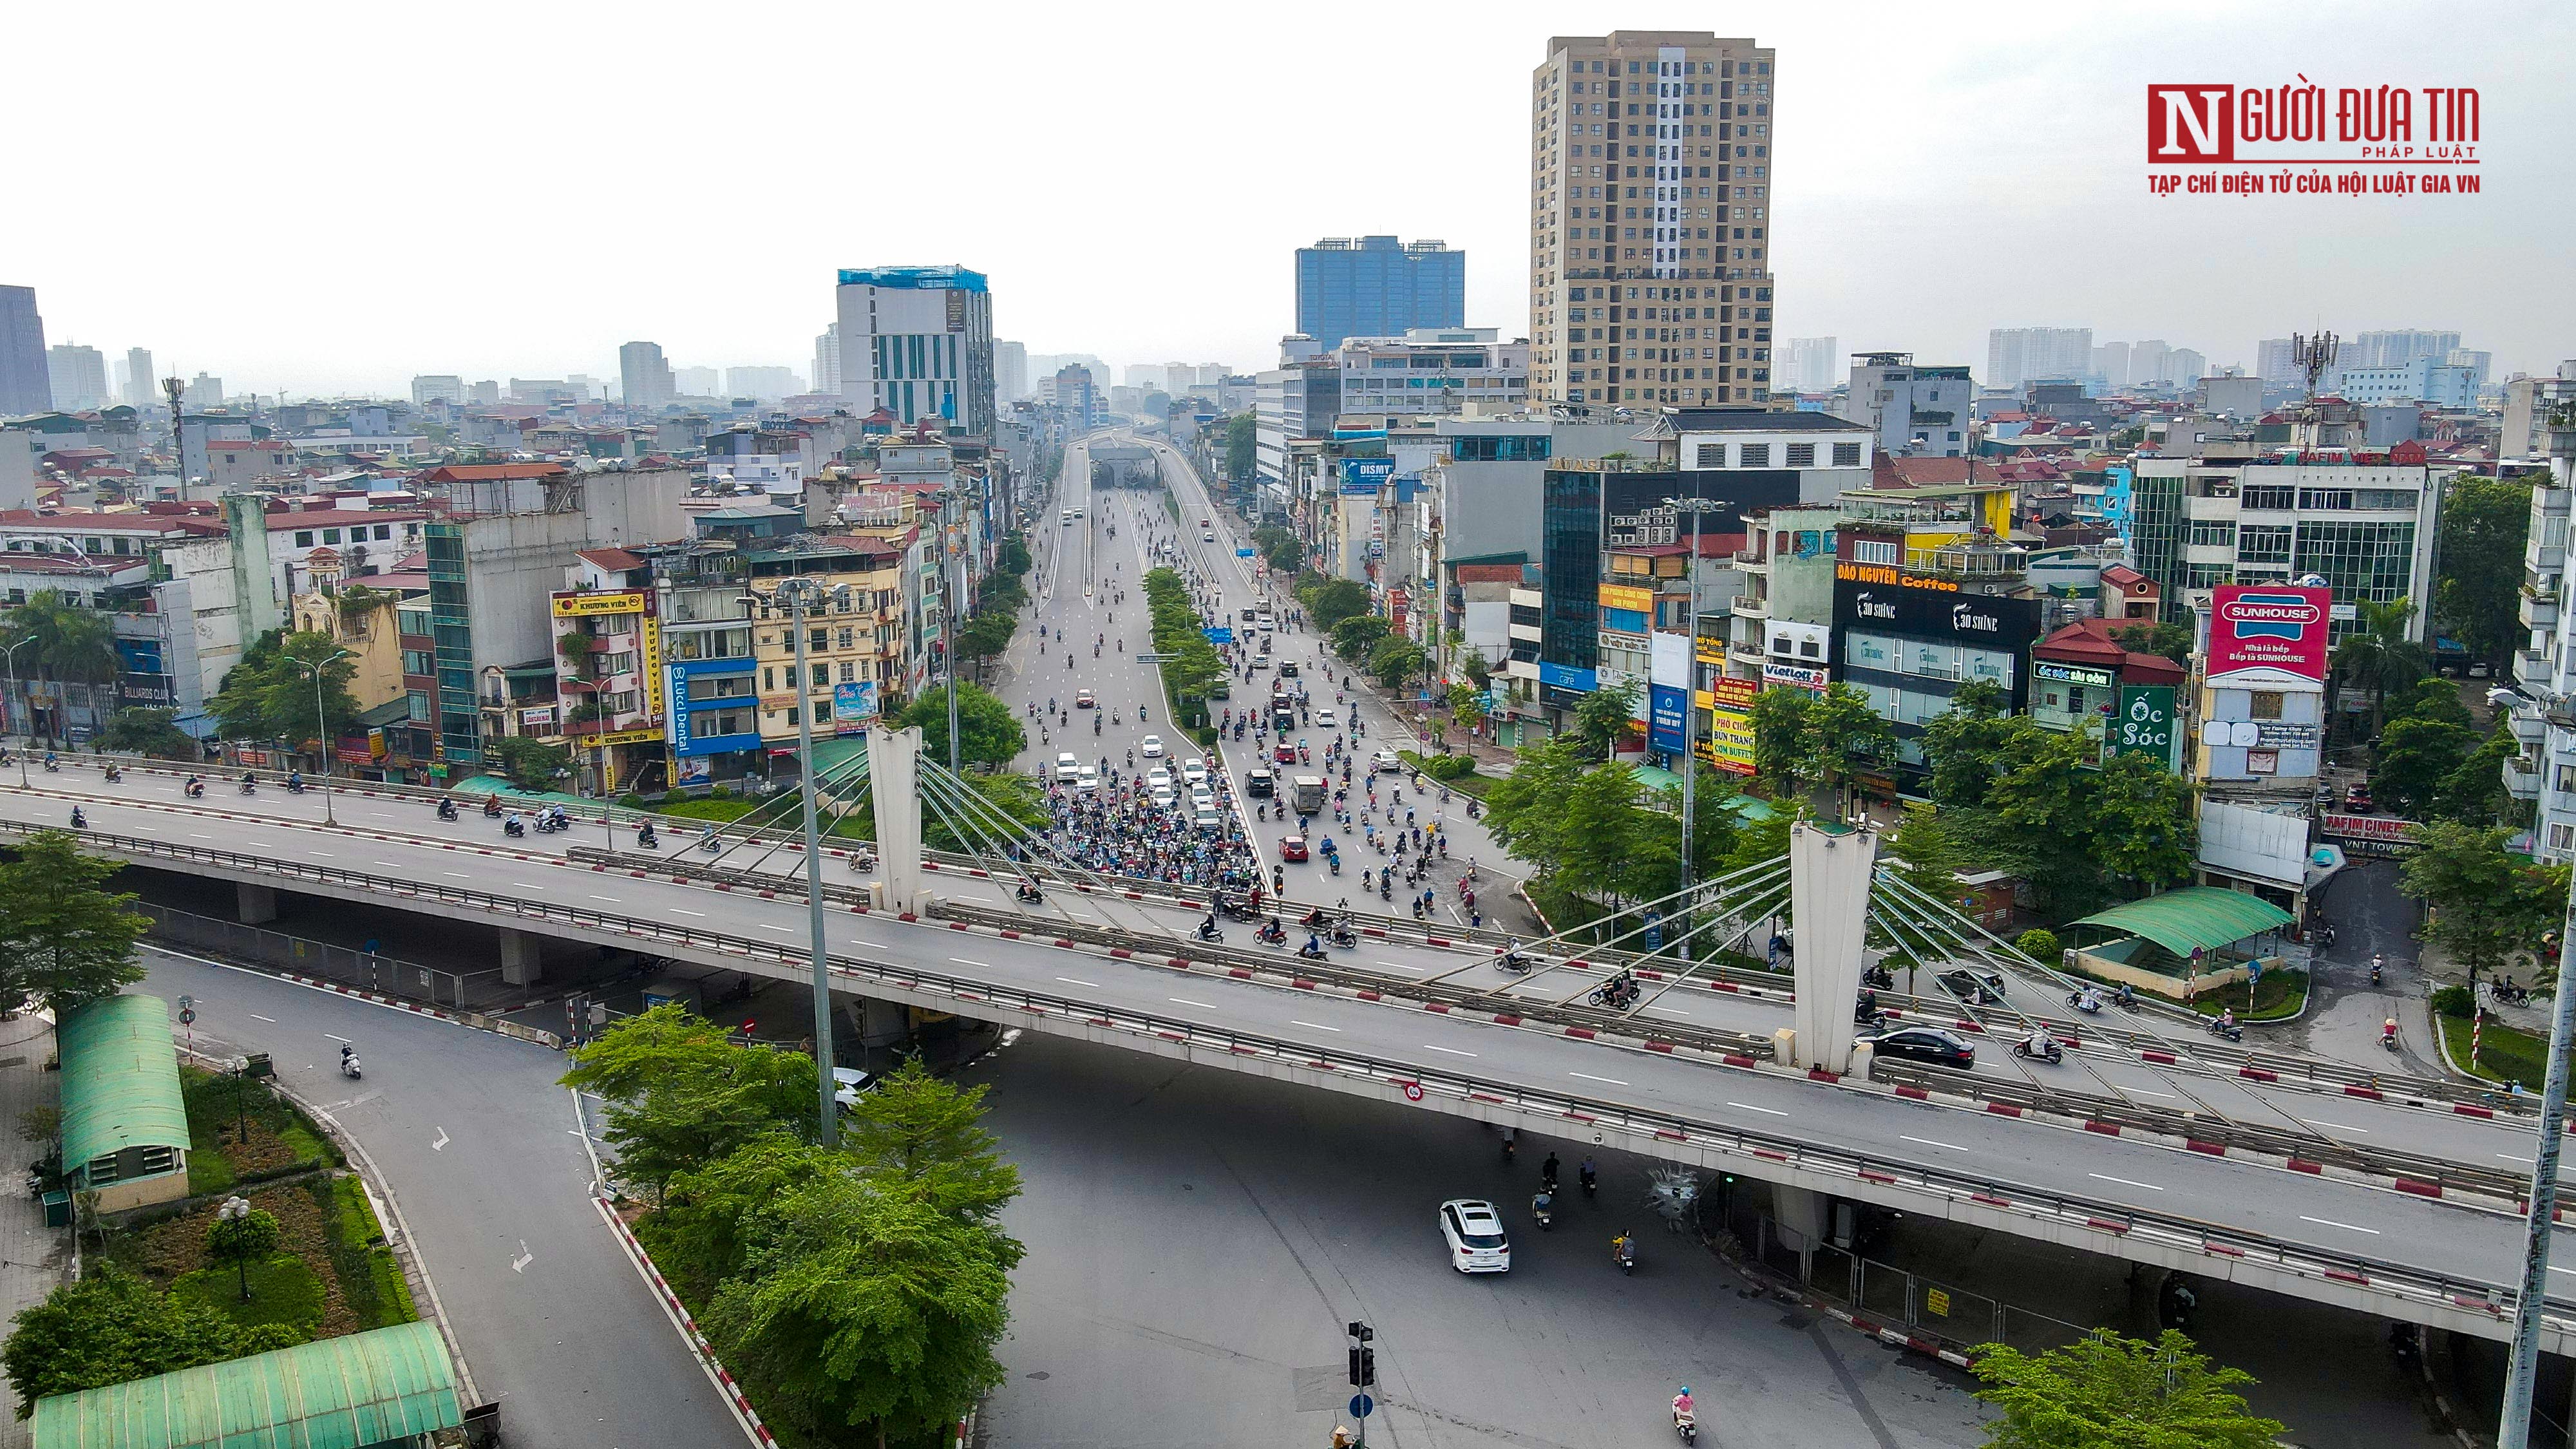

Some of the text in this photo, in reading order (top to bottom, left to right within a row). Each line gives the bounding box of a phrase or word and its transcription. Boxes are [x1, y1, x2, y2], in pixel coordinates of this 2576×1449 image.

[1360, 464, 1390, 475] DISMY
[1838, 562, 1958, 592] ĐÀO NGUYÊN Coffee
[2231, 606, 2309, 620] SUNHOUSE
[2273, 643, 2289, 654] bếp
[2229, 651, 2246, 661] Bếp
[2257, 654, 2306, 663] SUNHOUSE
[125, 687, 153, 699] BILLIARDS
[2131, 692, 2163, 723] Ốc
[1716, 716, 1730, 728] PHỞ
[677, 714, 689, 751] Dental
[1714, 729, 1754, 747] BÚN THANG
[2123, 723, 2167, 746] Sóc
[2345, 840, 2368, 849] VNT
